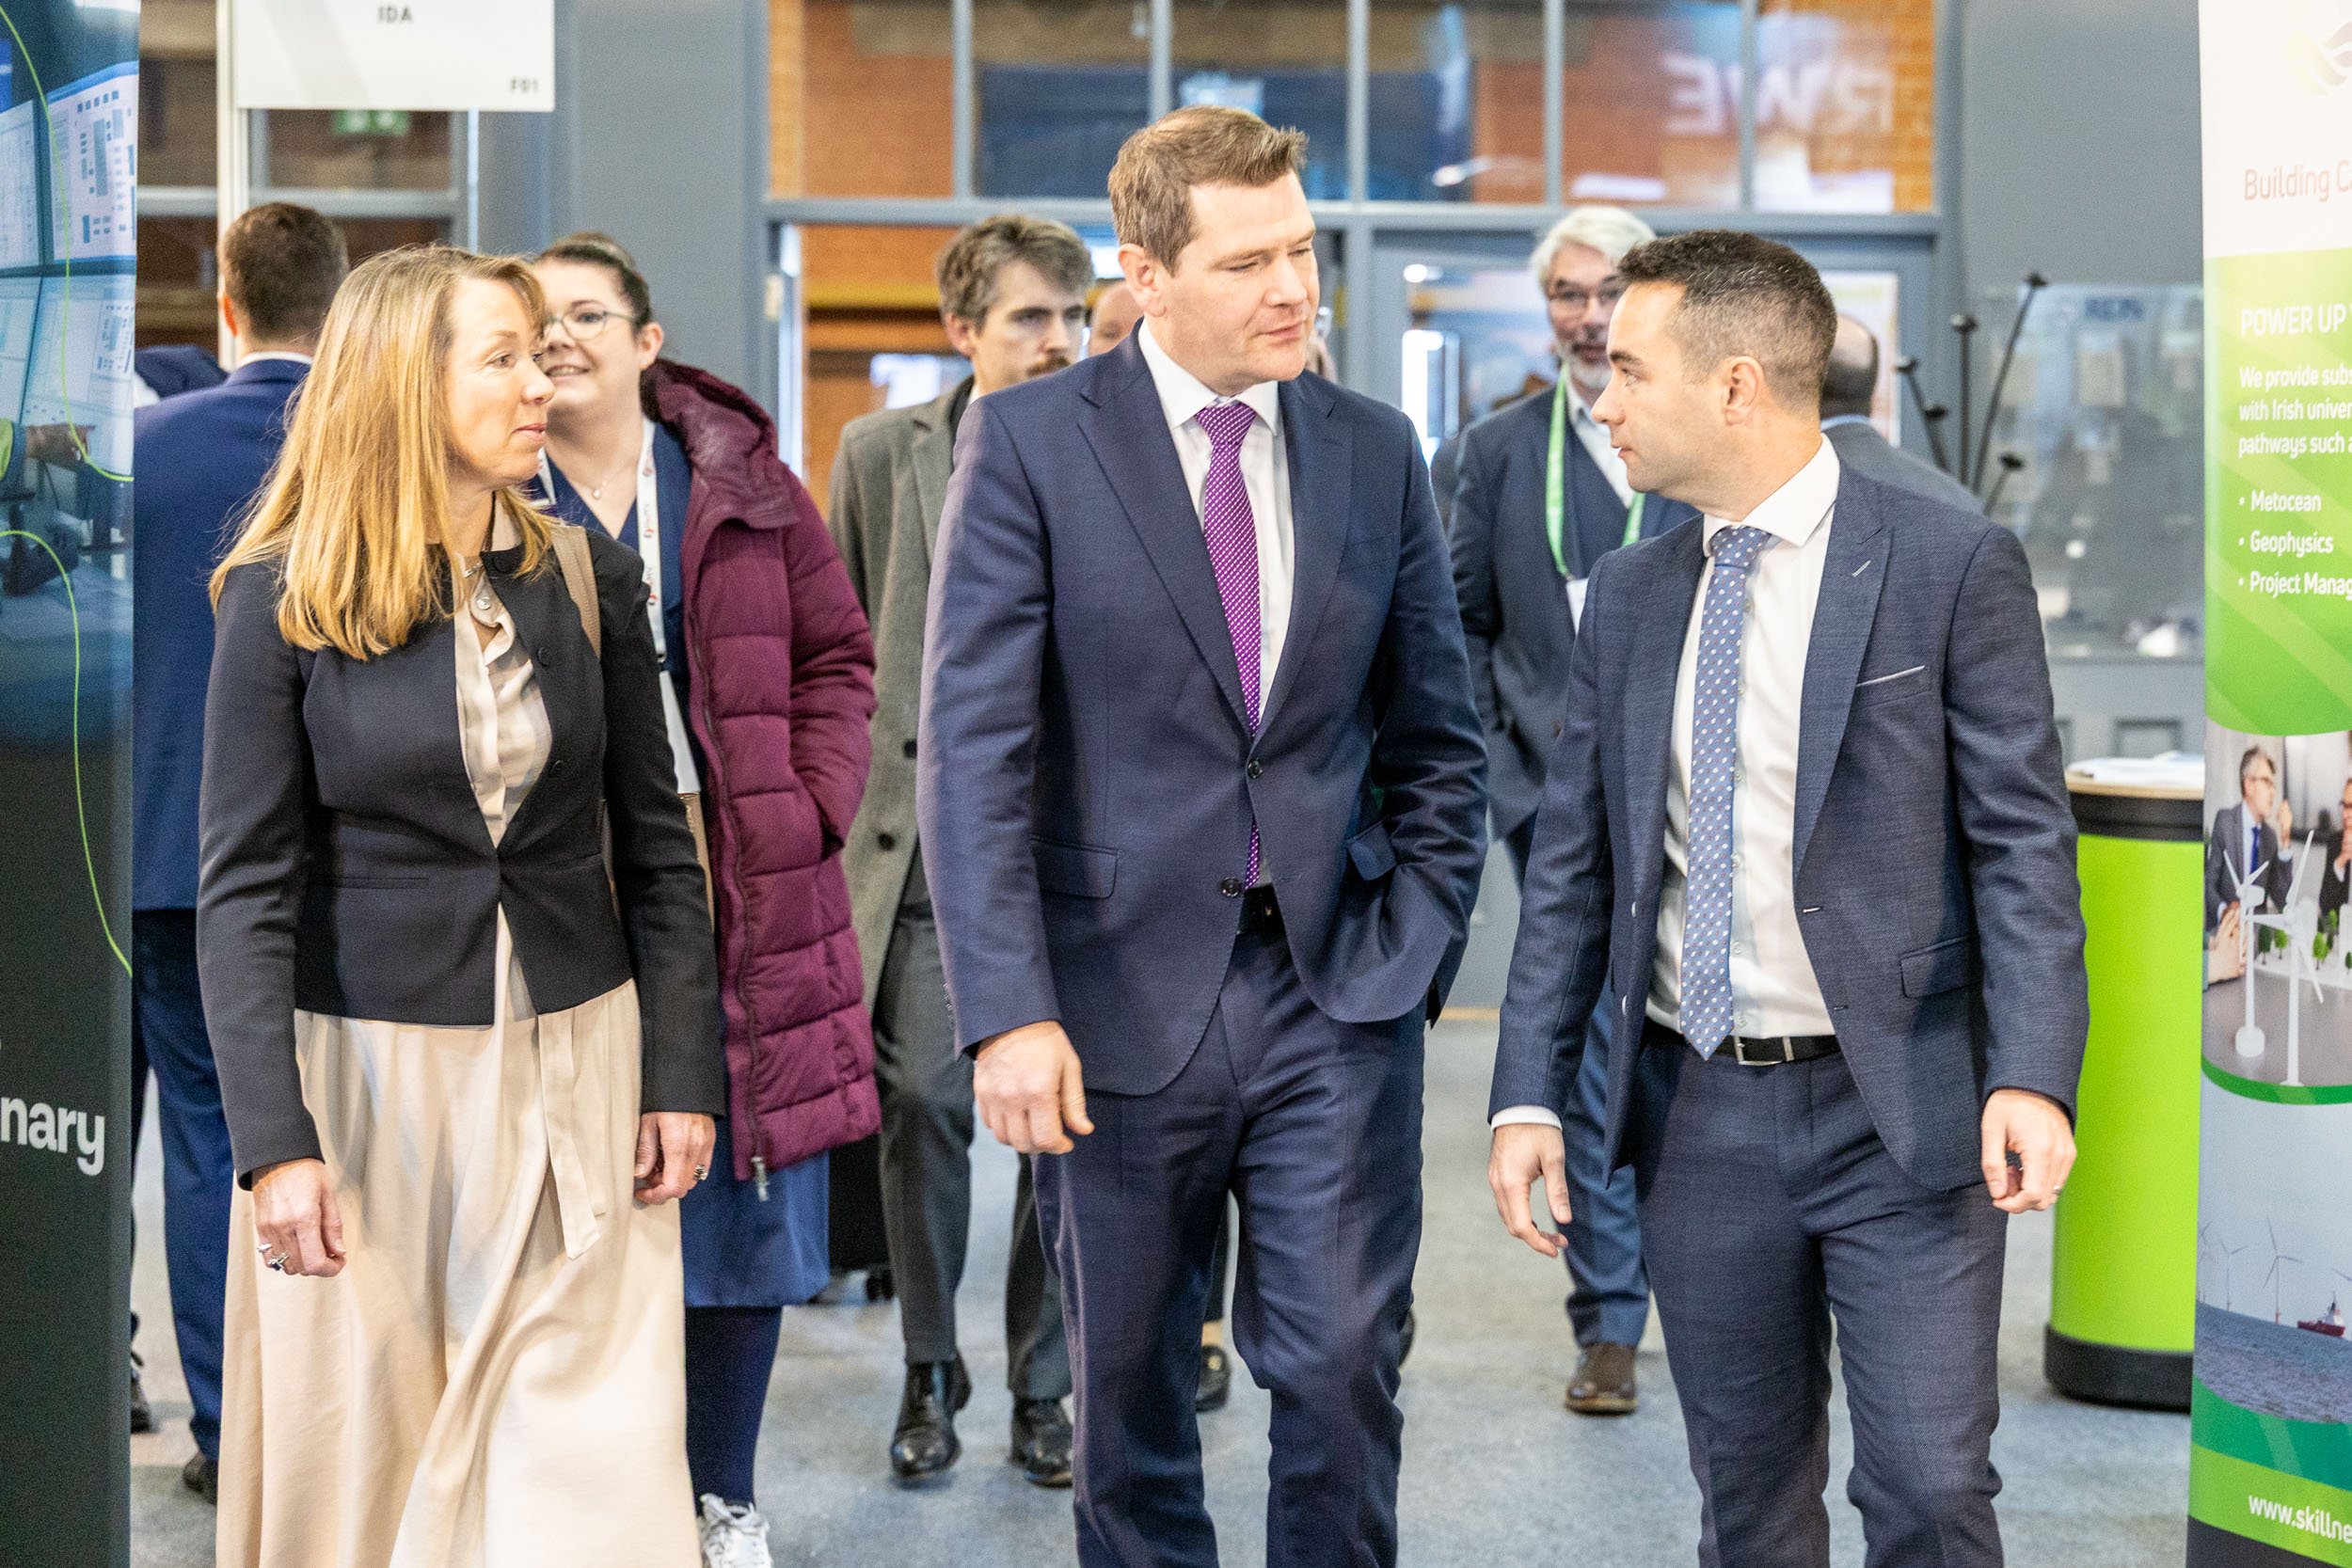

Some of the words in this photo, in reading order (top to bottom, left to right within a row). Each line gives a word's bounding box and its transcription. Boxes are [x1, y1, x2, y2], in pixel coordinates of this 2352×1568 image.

[377, 6, 413, 24] IDA
[2243, 163, 2330, 203] Building
[2336, 158, 2352, 194] C
[2240, 305, 2314, 337] POWER
[2318, 302, 2347, 333] UP
[2239, 365, 2263, 388] We
[2265, 364, 2318, 392] provide
[2239, 400, 2269, 422] with
[2272, 397, 2304, 420] Irish
[2238, 432, 2306, 460] pathways
[2310, 430, 2345, 454] such
[2250, 488, 2322, 513] Metocean
[2249, 529, 2334, 559] Geophysics
[2249, 570, 2301, 599] Project
[2304, 571, 2352, 602] Manag
[0, 1096, 105, 1176] nary
[2248, 1495, 2352, 1544] www.skillne
